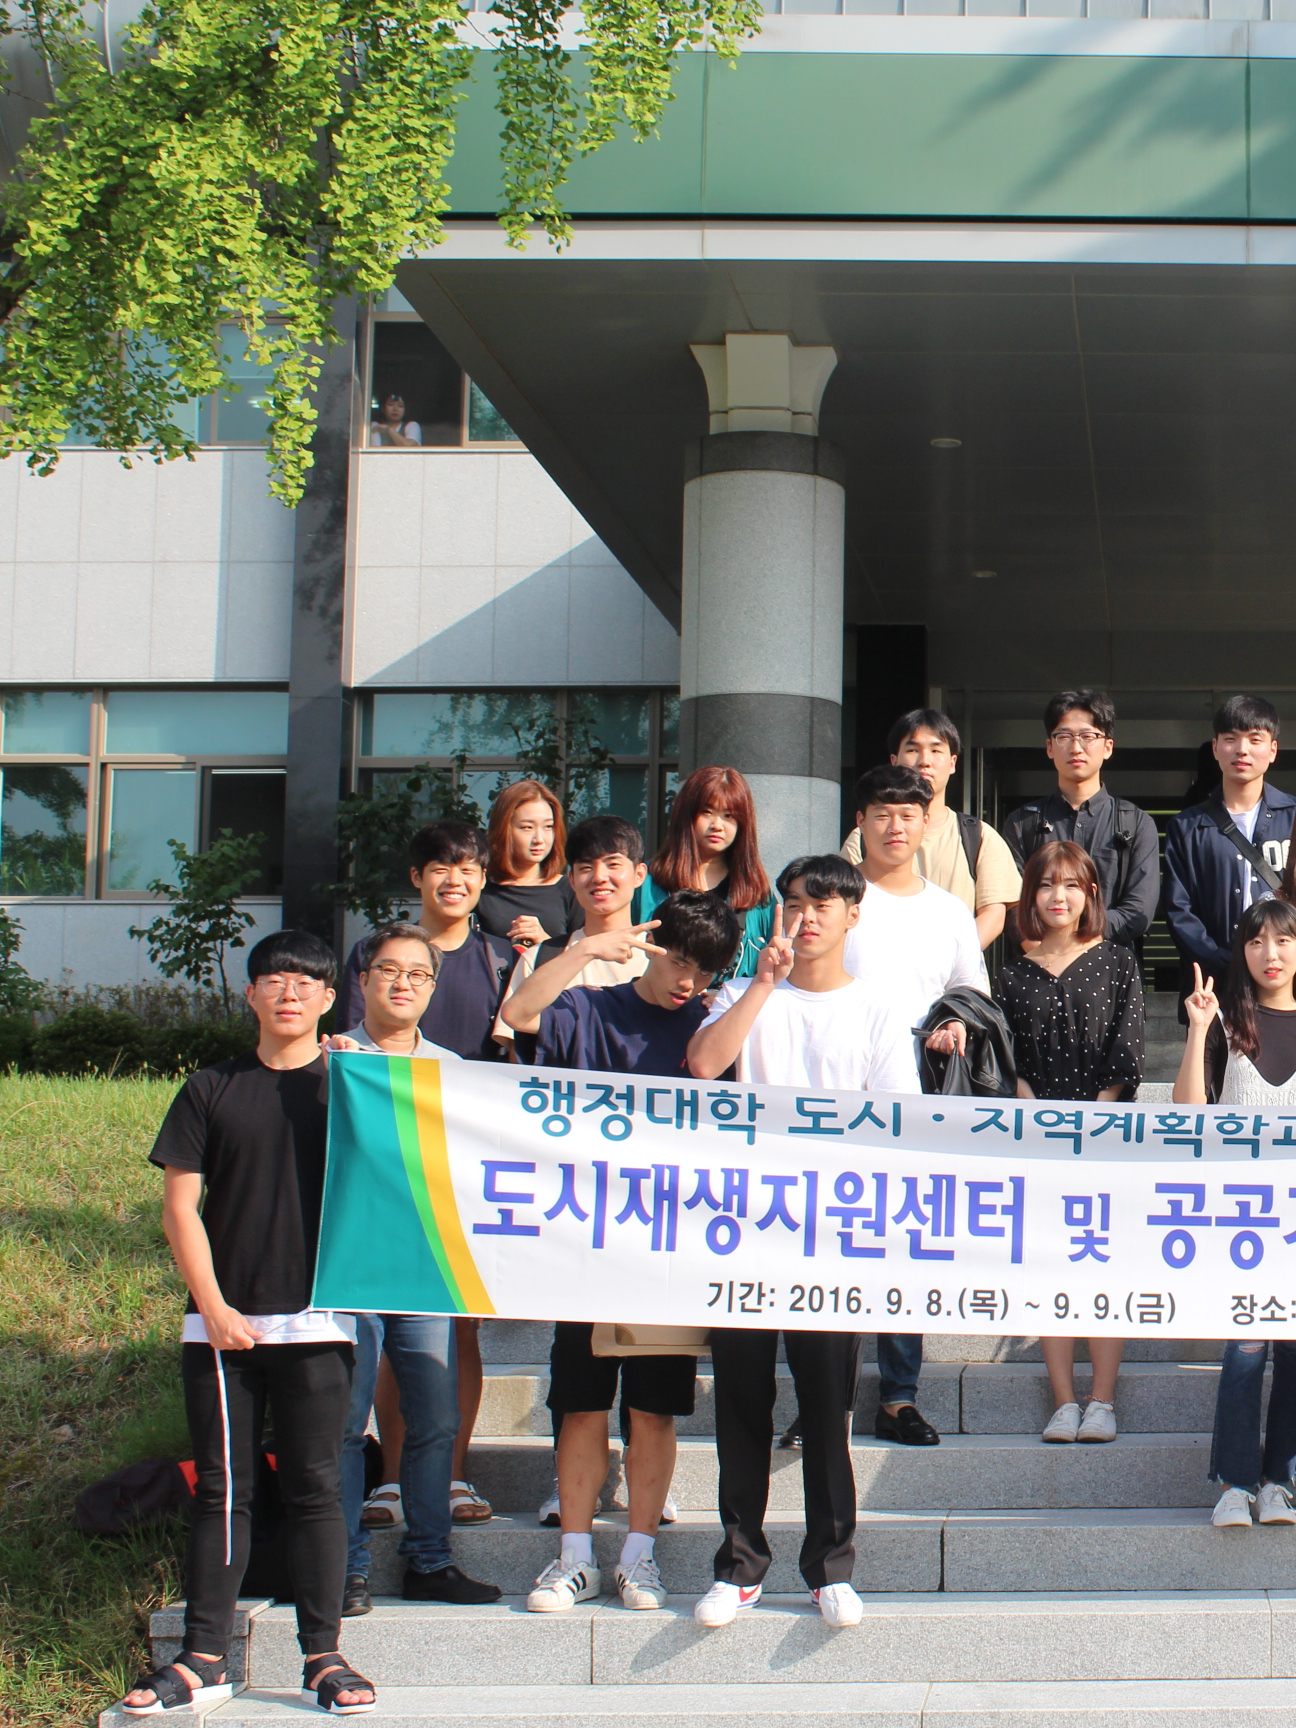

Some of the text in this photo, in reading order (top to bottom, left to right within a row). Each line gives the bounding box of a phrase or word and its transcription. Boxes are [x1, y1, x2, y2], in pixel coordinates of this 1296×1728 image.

[519, 1077, 765, 1145] 행정대학
[788, 1097, 901, 1137] 도시
[473, 1161, 1024, 1264] 도시재생지원센터
[1062, 1194, 1110, 1262] 및
[708, 1281, 775, 1313] 기간:
[790, 1285, 871, 1314] 2016.
[887, 1288, 911, 1315] 9.
[927, 1288, 1008, 1320] 8.(목)
[1055, 1293, 1079, 1320] 9.
[1094, 1292, 1175, 1324] 9.(금)
[1231, 1295, 1296, 1325] 장소:
